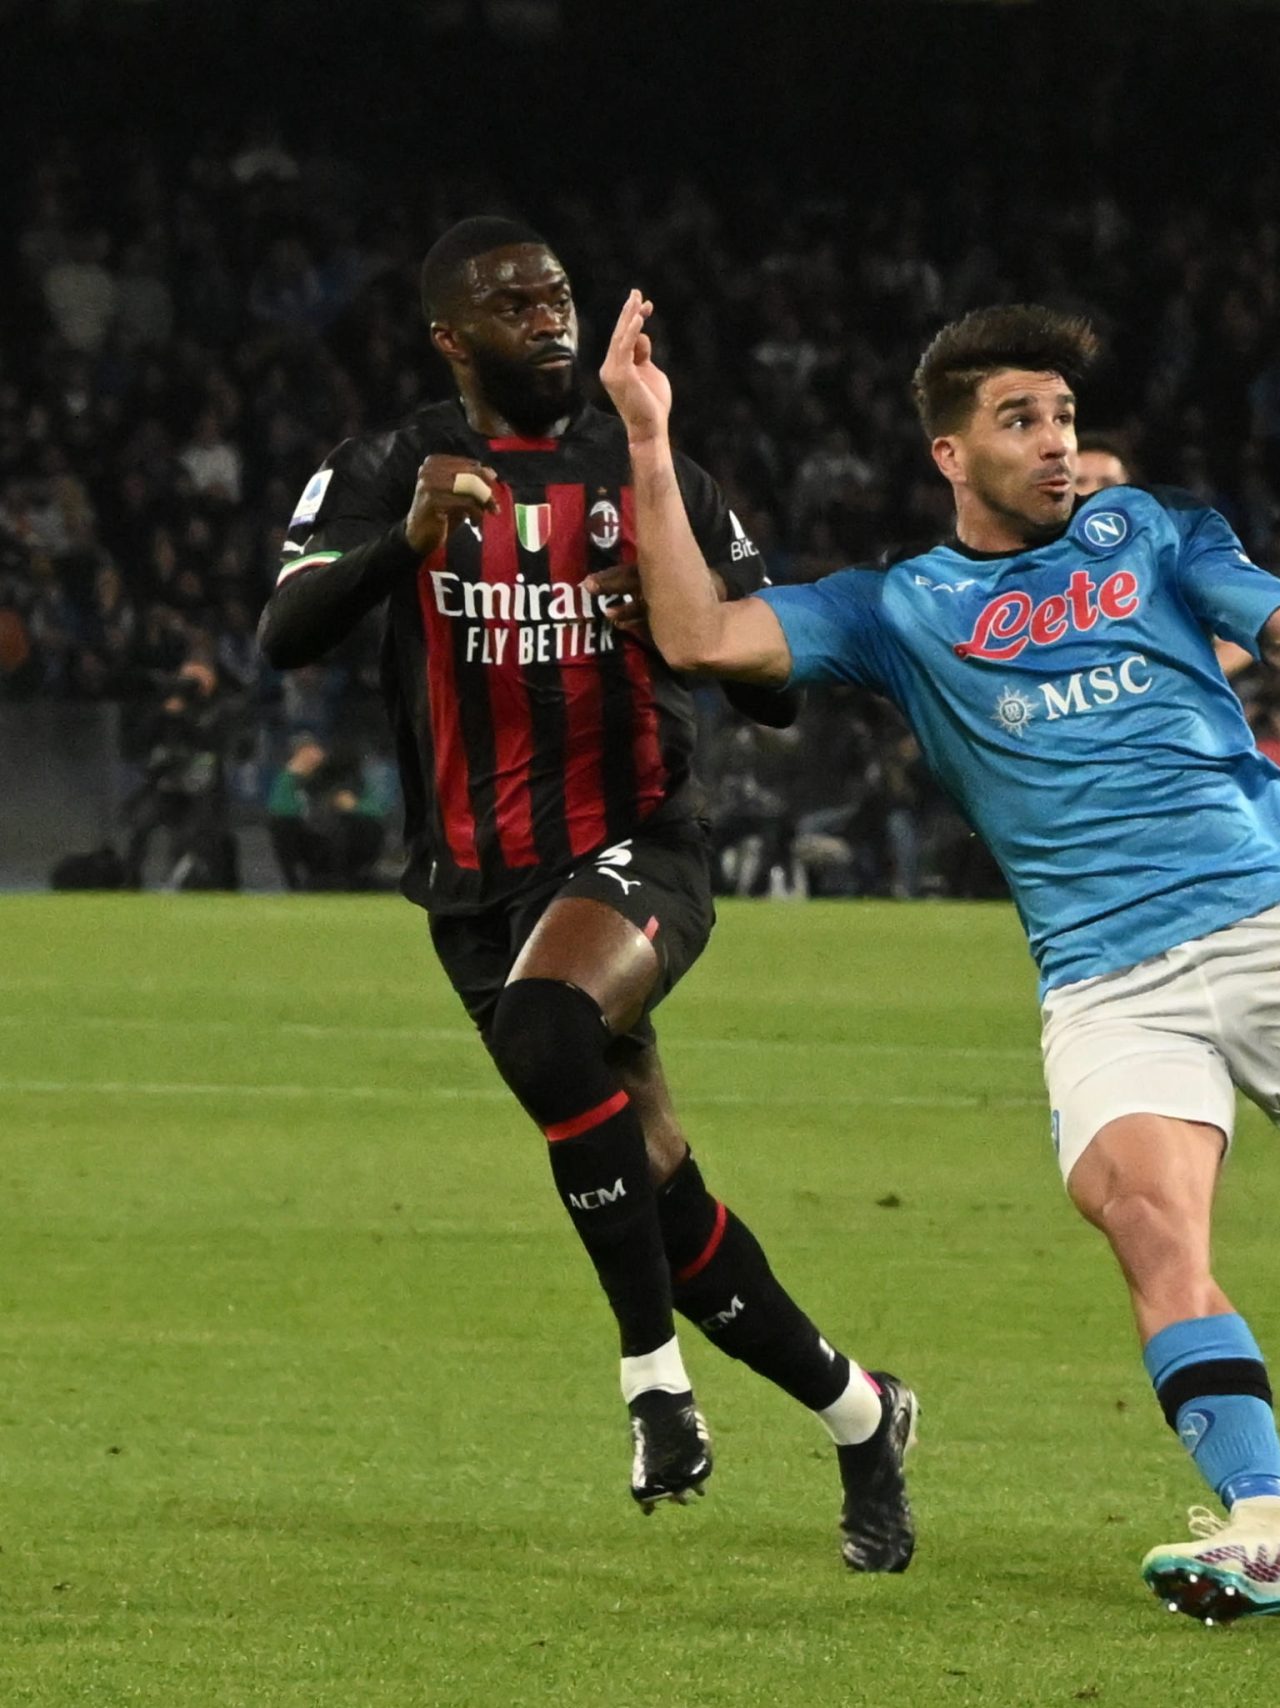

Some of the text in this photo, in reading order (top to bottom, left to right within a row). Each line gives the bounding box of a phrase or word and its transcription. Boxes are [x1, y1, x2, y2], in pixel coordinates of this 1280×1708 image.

[1090, 517, 1120, 542] N
[953, 570, 1140, 661] Lete
[466, 622, 615, 666] FLY BETTER
[1038, 654, 1153, 721] MSC
[568, 1176, 627, 1210] ACM
